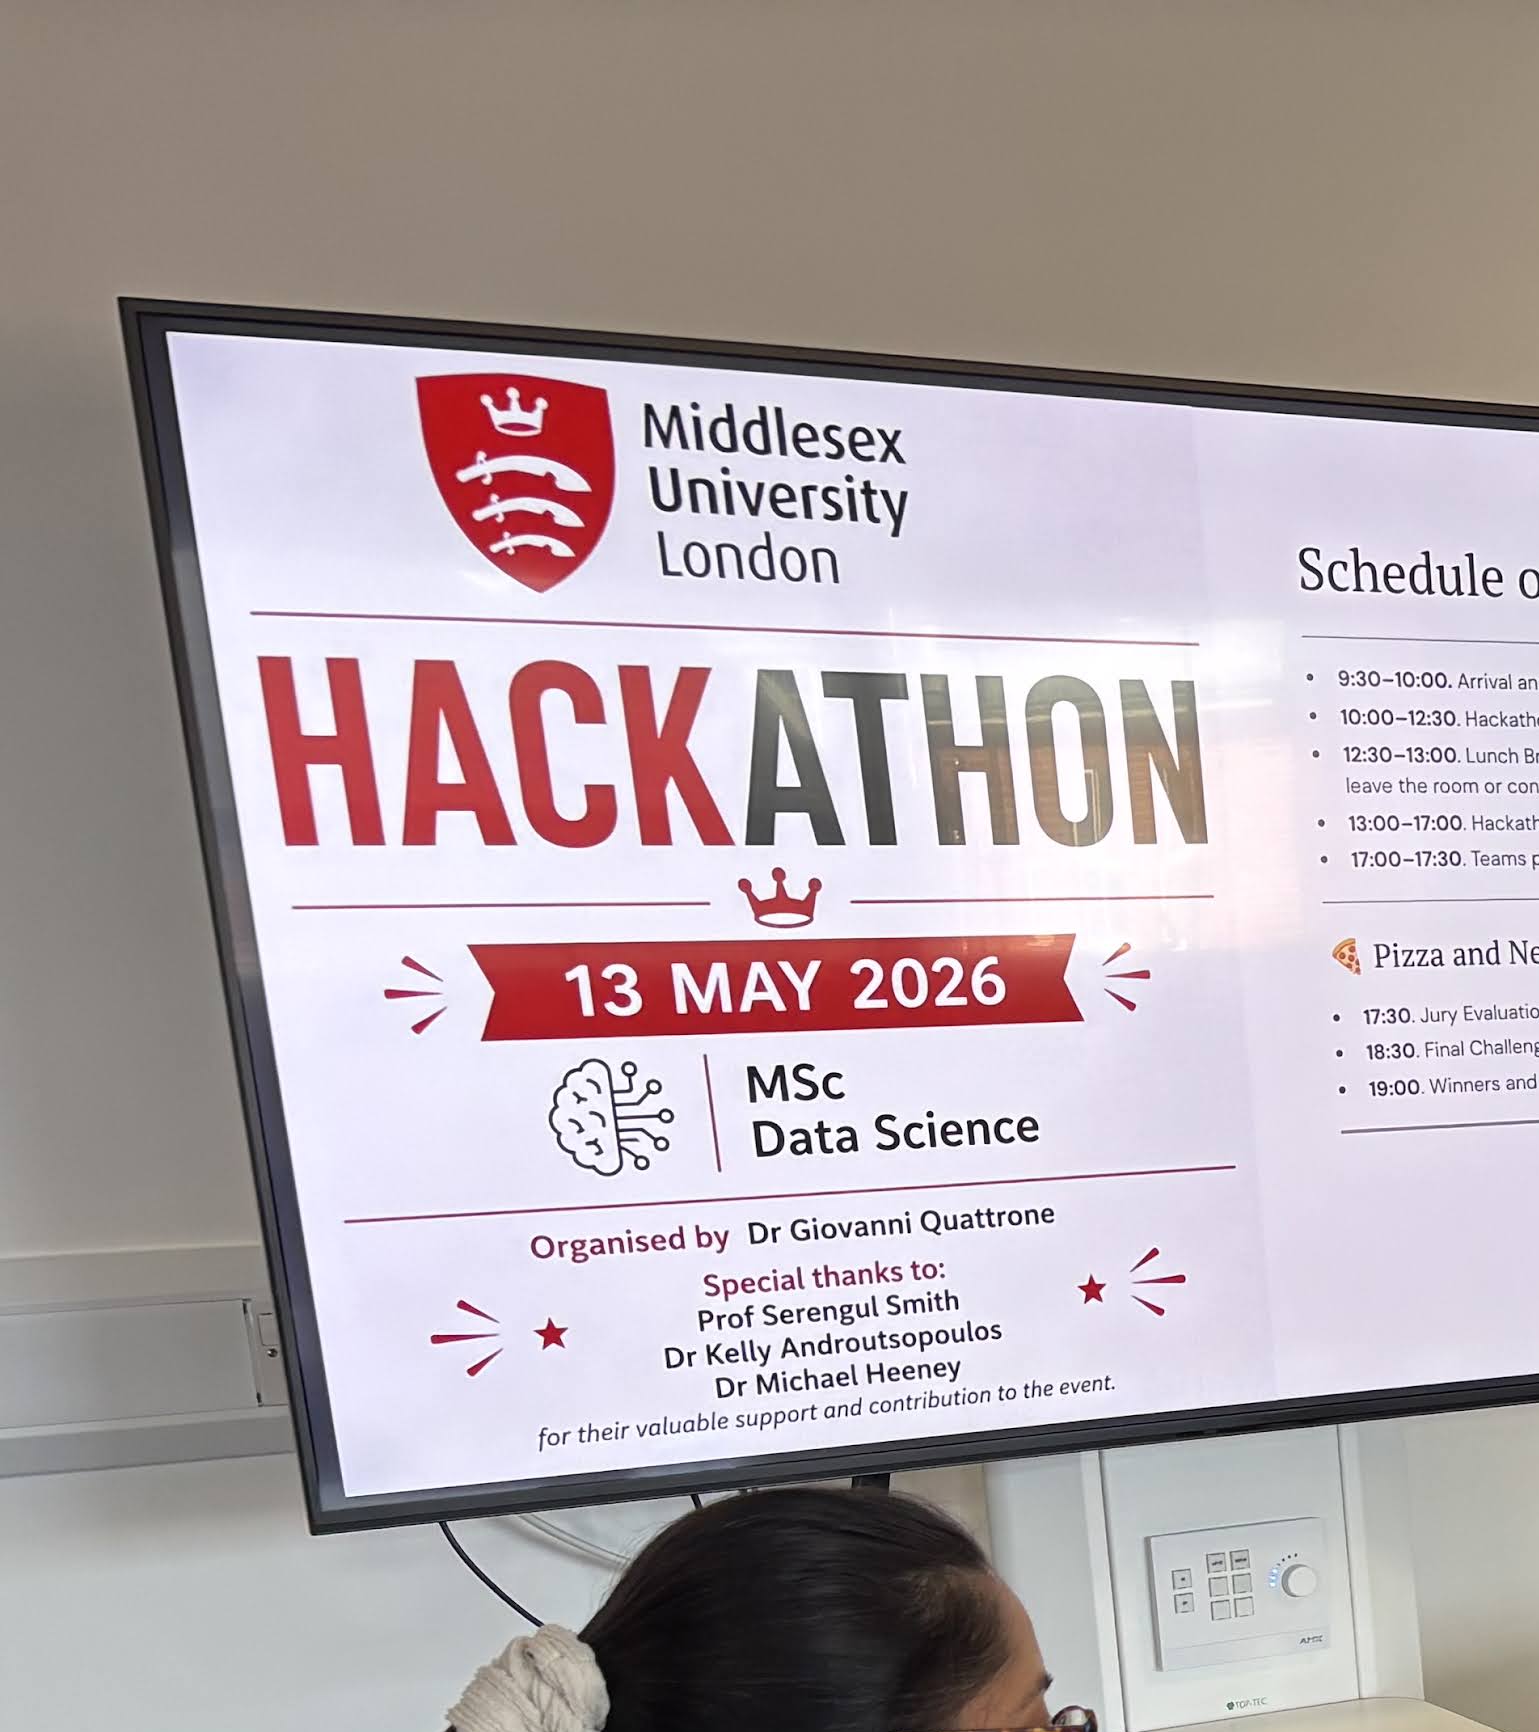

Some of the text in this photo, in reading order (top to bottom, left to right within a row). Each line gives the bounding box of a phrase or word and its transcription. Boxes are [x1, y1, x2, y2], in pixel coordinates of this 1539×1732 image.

[643, 403, 907, 465] Middlesex
[648, 466, 909, 538] University
[657, 530, 840, 584] London
[1298, 547, 1504, 598] Schedule
[1457, 672, 1513, 690] Arrival
[257, 655, 1208, 849] HACKATHON
[1465, 747, 1519, 764] Lunch
[1346, 777, 1393, 794] leave
[1398, 777, 1428, 794] the
[1433, 781, 1479, 794] room
[1484, 781, 1503, 794] or
[1470, 850, 1527, 867] Teams
[1373, 942, 1445, 969] Pizza
[1453, 939, 1501, 967] and
[564, 955, 1006, 1017] 13 MAY 2026
[1363, 1007, 1416, 1025] 17:30.
[1420, 1007, 1458, 1027] Jury
[1366, 1042, 1420, 1061] 18:30.
[1424, 1040, 1465, 1058] Final
[746, 1063, 846, 1104] MSc
[1368, 1078, 1425, 1097] 19:00.
[1429, 1077, 1501, 1094] Winners
[1506, 1073, 1538, 1091] and
[752, 1110, 1039, 1158] Data Science
[530, 1207, 1055, 1264] Organised by Dr Giovanni Quattrone
[703, 1260, 946, 1303] Special thanks to:
[697, 1288, 959, 1332] Prof Serengul Smith
[664, 1320, 1003, 1369] Dr Kelly Androutsopoulos
[715, 1360, 961, 1399] Dr Michael Heeney
[538, 1375, 1116, 1453] for their valuable support and contribution to the event.
